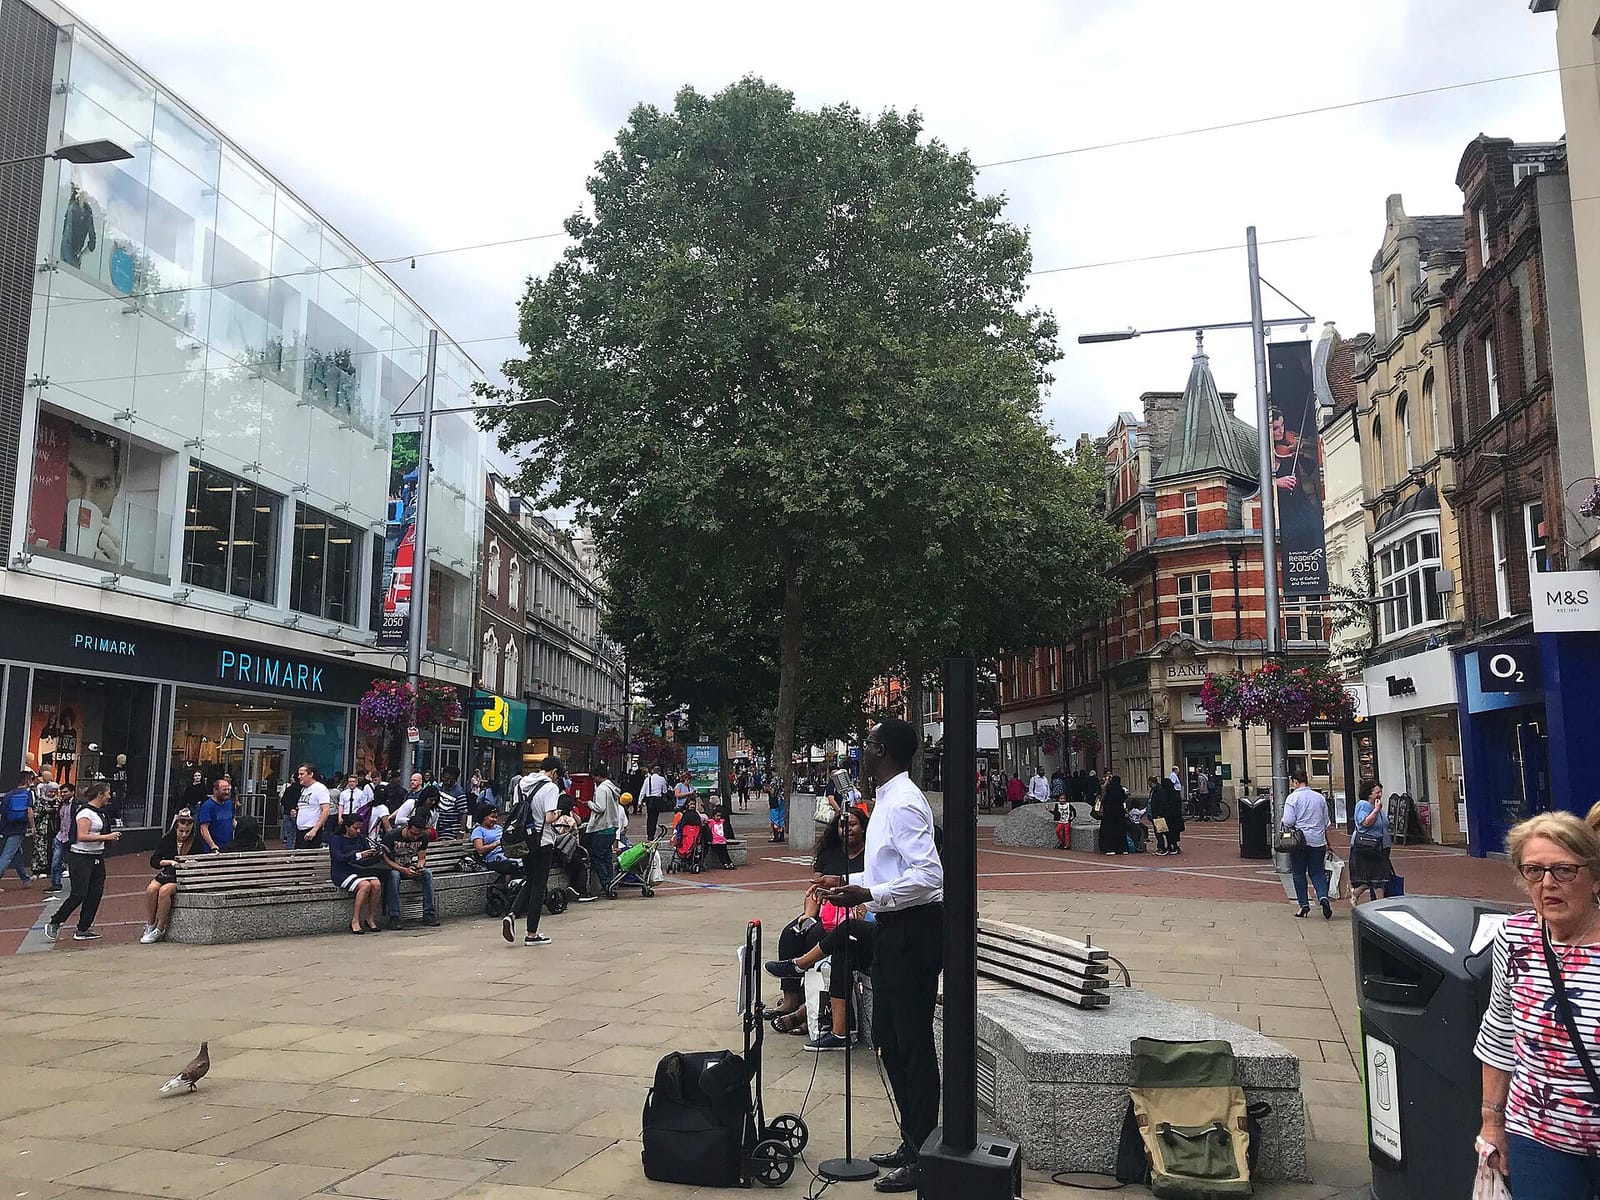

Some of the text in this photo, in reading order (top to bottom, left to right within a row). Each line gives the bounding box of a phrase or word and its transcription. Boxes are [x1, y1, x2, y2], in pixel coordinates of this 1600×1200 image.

[1289, 561, 1319, 572] 2050
[1547, 590, 1589, 605] M&S
[383, 617, 404, 627] 2050
[74, 634, 136, 657] PRIMARK
[220, 650, 323, 693] PRIMARK
[1167, 664, 1207, 677] BANK
[1489, 653, 1525, 683] O2
[38, 704, 56, 712] NEW
[540, 711, 565, 724] John
[551, 722, 579, 733] Lewis
